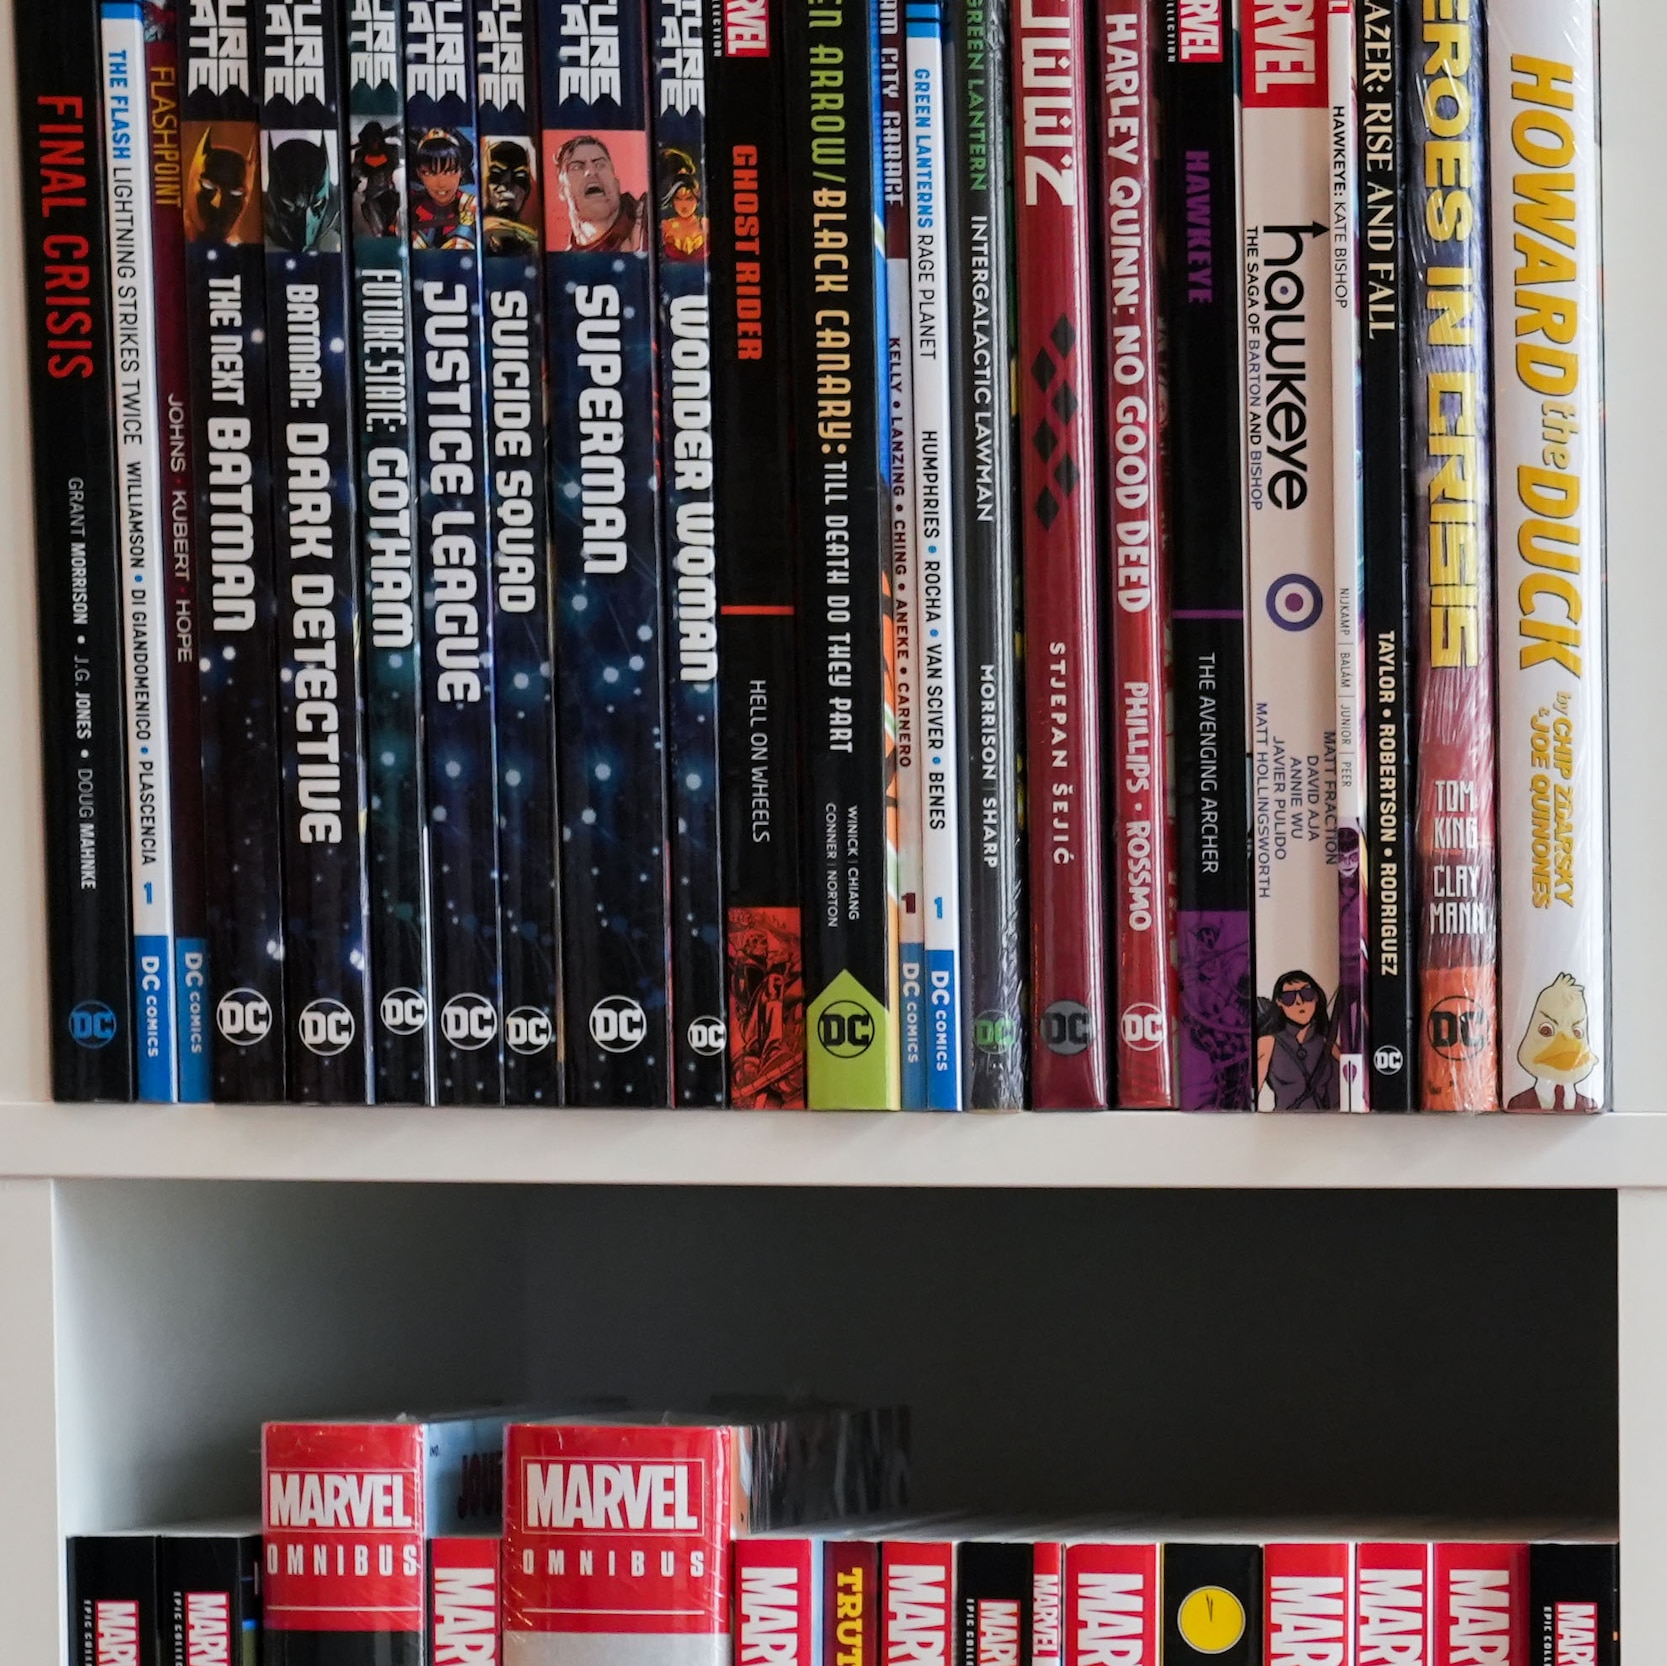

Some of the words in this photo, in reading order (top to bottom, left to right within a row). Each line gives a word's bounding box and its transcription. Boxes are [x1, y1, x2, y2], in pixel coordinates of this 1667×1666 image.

[109, 50, 127, 88] THE
[38, 96, 86, 217] FINAL
[110, 96, 131, 159] FLASH
[1333, 106, 1346, 196] HAWKEYE:
[113, 168, 136, 278] LIGHTNING
[733, 145, 759, 255] GHOST
[1334, 202, 1346, 242] KATE
[1510, 54, 1580, 397] HOWARD
[43, 235, 94, 378] CRISIS
[736, 262, 762, 359] RIDER
[1335, 248, 1347, 308] BISHOP
[118, 286, 139, 372] STRIKES
[122, 379, 142, 444] TWICE
[491, 291, 531, 456] SUICIDE
[574, 283, 628, 574] SUPERMAN
[1541, 404, 1577, 469] the
[495, 470, 535, 612] SQUAD
[1515, 465, 1583, 678] DUCK
[750, 680, 767, 727] HELL
[1379, 631, 1395, 703] TAYLOR
[751, 733, 768, 760] ON
[1379, 724, 1396, 841] ROBERTSON
[751, 766, 770, 842] WHEELS
[1381, 863, 1397, 975] RODRIGUEZ
[268, 1472, 413, 1528] MARVEL
[265, 1545, 419, 1576] OMNIBUS
